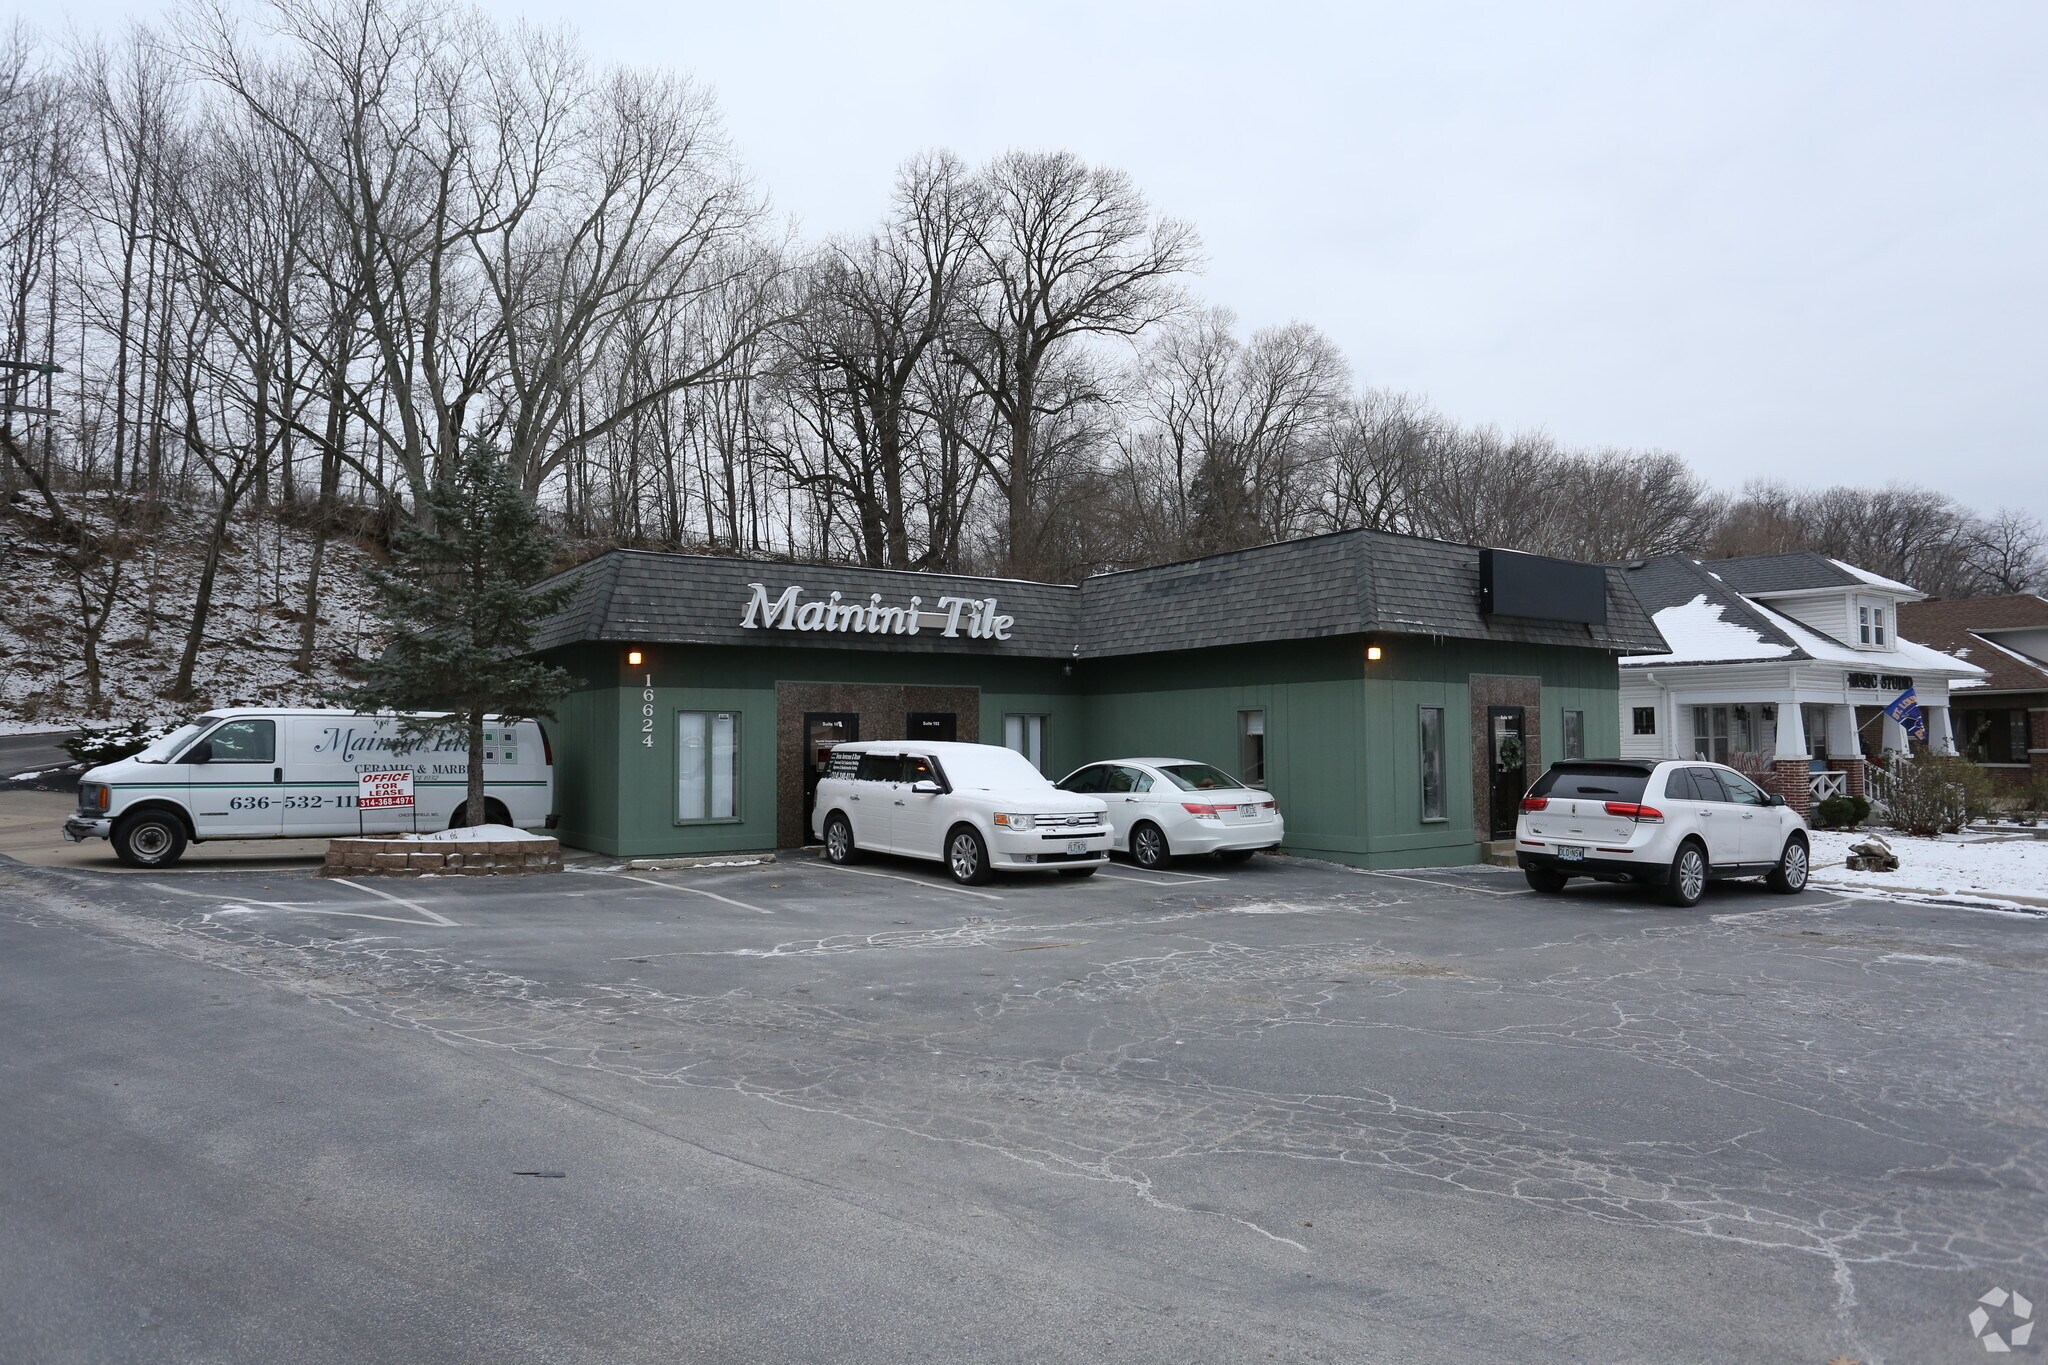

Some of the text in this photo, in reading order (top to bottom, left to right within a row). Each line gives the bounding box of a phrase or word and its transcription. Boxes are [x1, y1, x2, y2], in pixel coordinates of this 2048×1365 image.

[739, 583, 1015, 640] Mainini Tile
[1847, 673, 1914, 690] MUSIC STUDIO
[641, 673, 654, 748] 16624
[417, 764, 427, 774] &
[432, 764, 469, 774] MARB
[362, 773, 410, 783] OFFICE
[369, 789, 404, 797] LEASE
[360, 796, 414, 807] 314-368-4971
